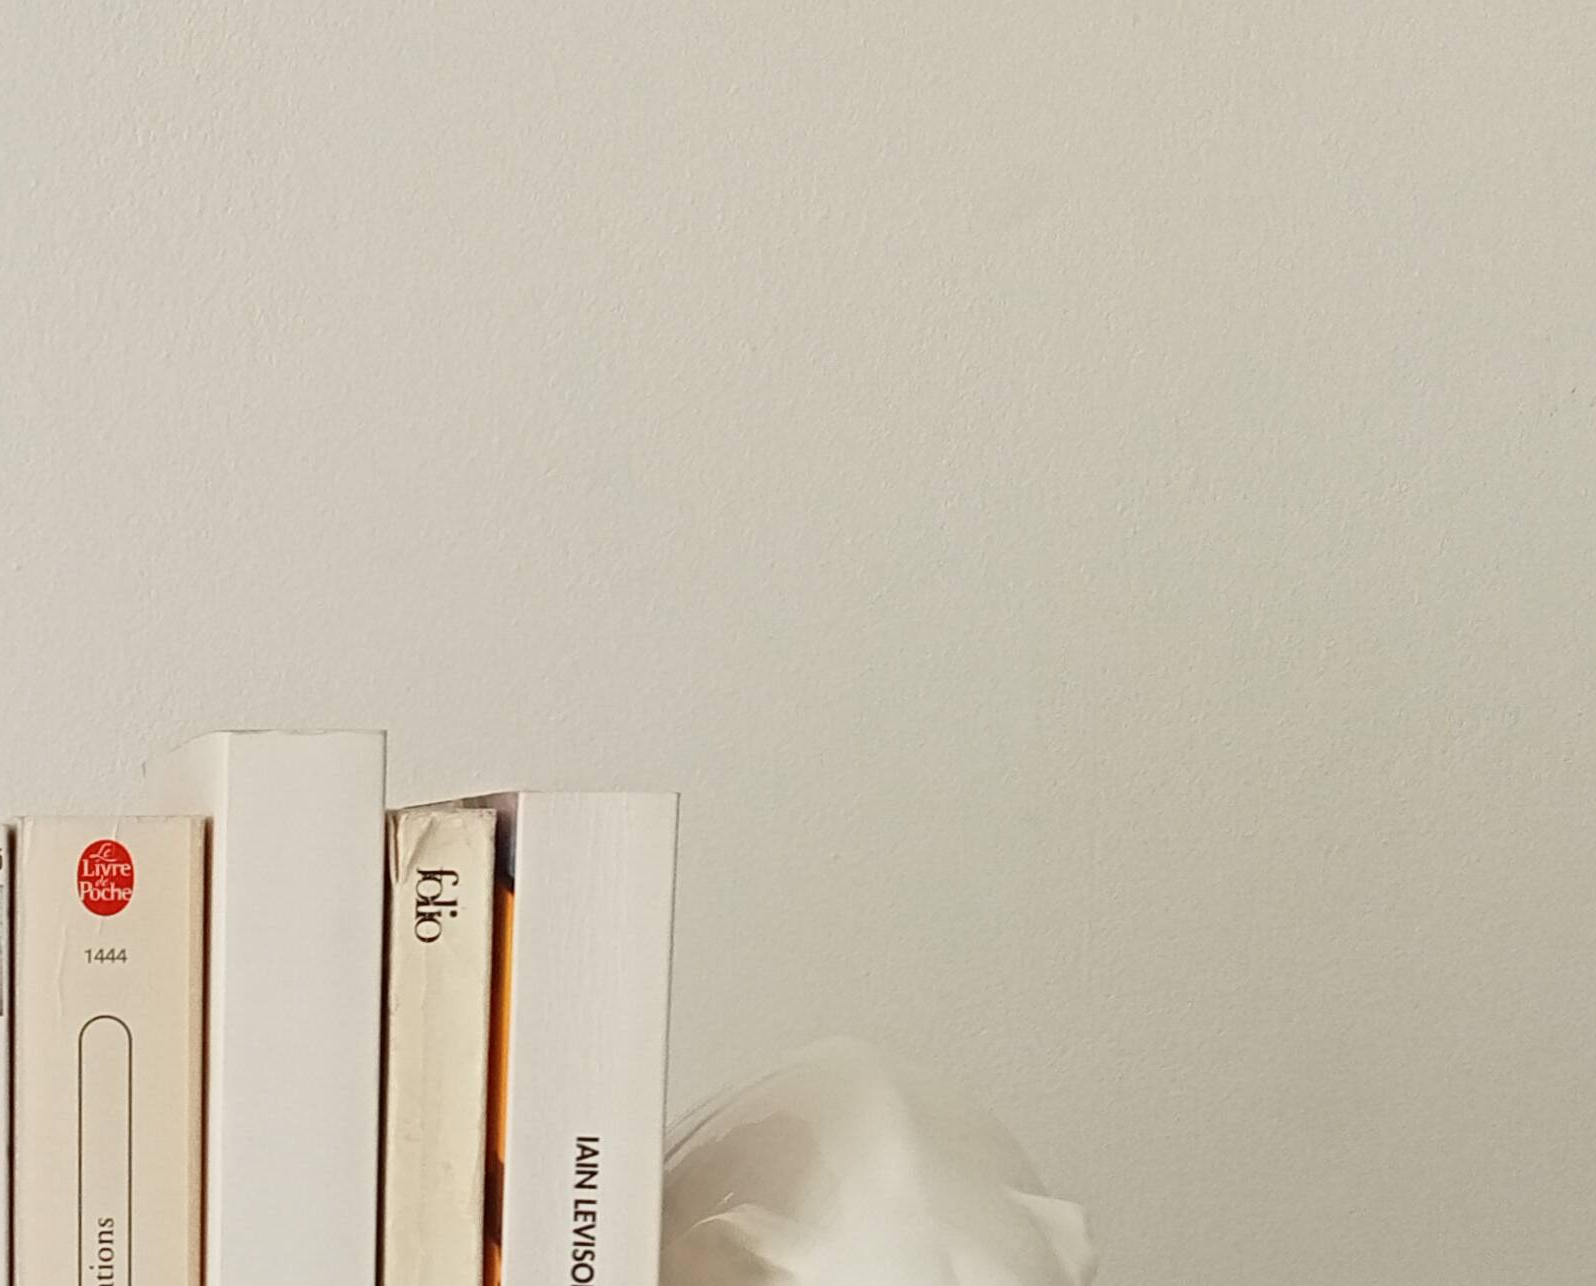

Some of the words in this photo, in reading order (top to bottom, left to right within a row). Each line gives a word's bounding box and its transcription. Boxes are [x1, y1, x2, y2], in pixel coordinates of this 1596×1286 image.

[89, 842, 116, 862] Le
[81, 859, 131, 877] Livre
[79, 881, 132, 901] Poche
[94, 876, 109, 887] de
[414, 866, 459, 944] folio
[84, 948, 127, 963] 1444
[575, 1136, 600, 1190] IAIN
